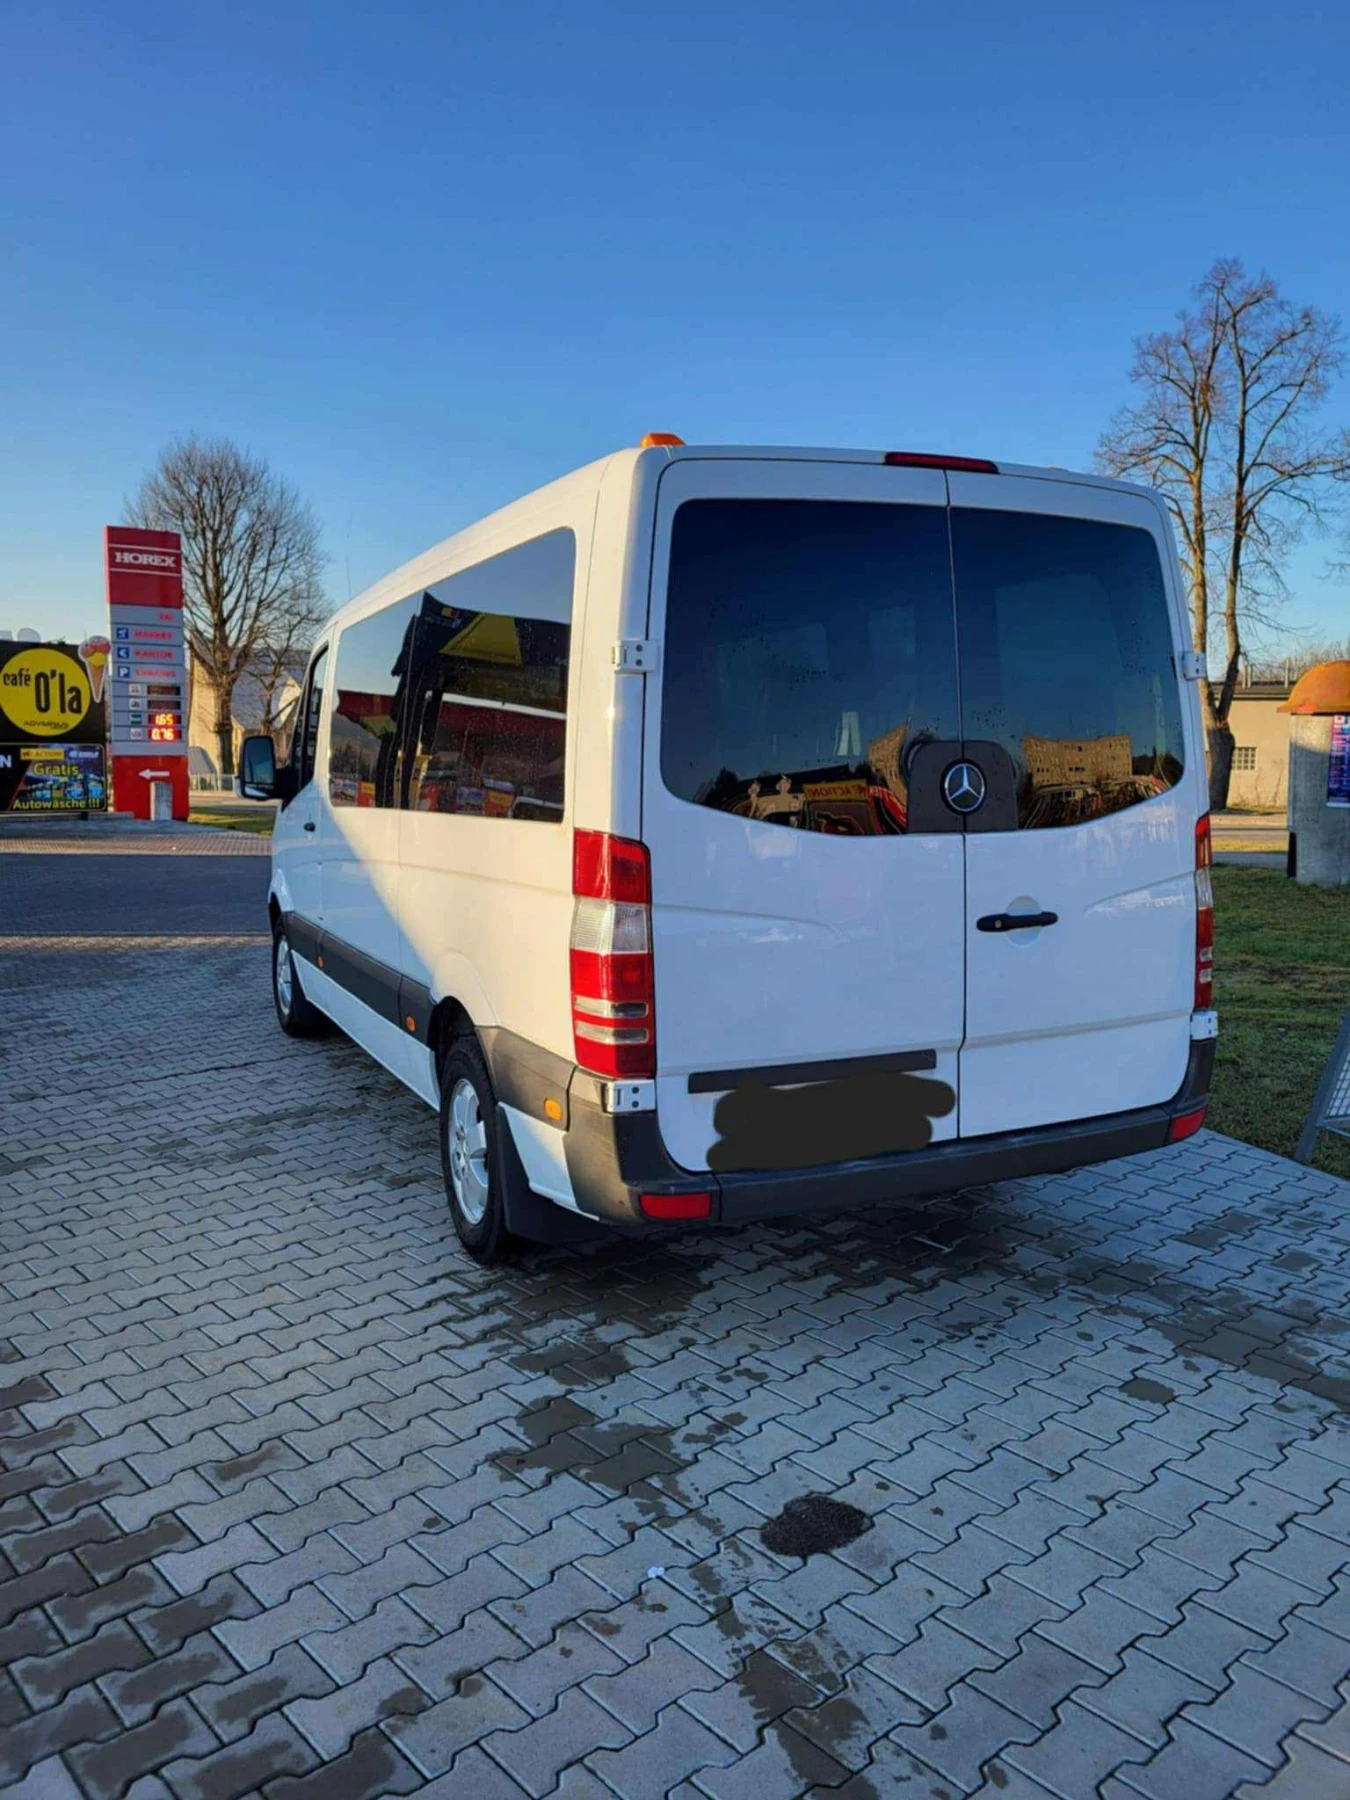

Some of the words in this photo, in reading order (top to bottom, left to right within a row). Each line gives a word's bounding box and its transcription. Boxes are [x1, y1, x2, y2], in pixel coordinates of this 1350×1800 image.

[115, 551, 176, 567] HOREX
[3, 668, 31, 687] café
[34, 762, 79, 775] Gratis
